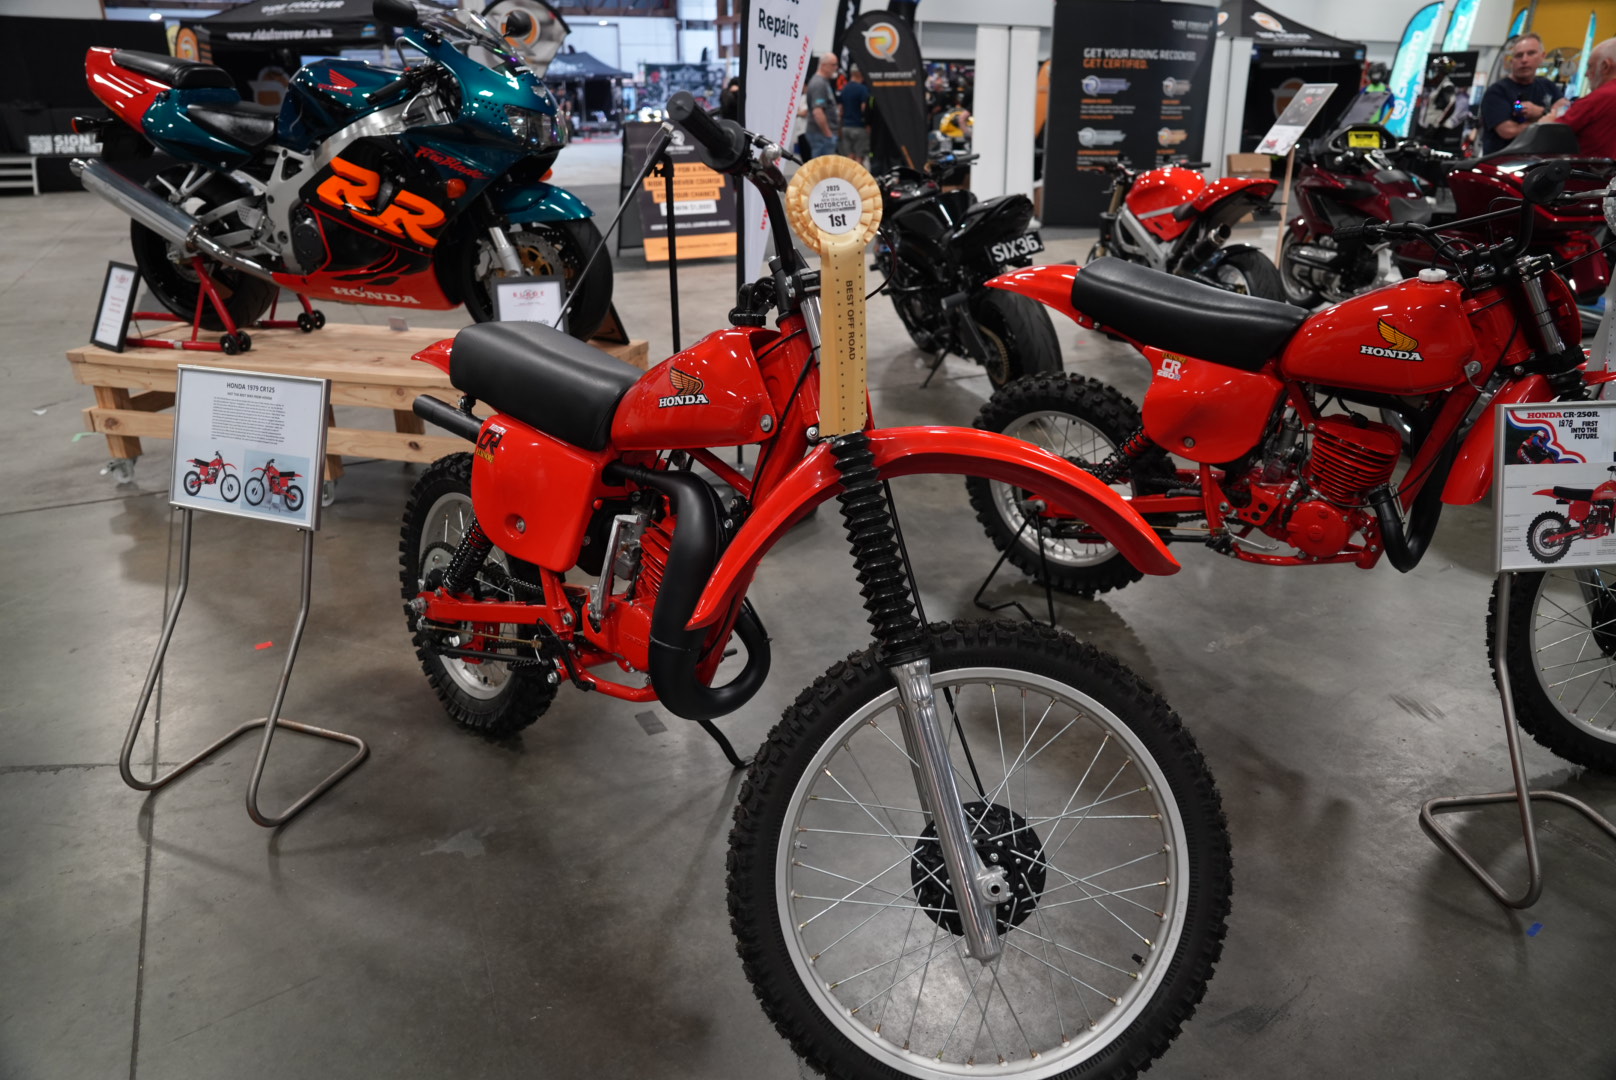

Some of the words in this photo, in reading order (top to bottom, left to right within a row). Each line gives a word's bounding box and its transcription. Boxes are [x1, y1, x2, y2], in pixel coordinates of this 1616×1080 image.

[758, 7, 799, 39] Repairs
[757, 43, 788, 71] Tyres
[1083, 47, 1102, 58] GET
[1103, 47, 1129, 59] YOUR
[1083, 58, 1102, 68] GET
[814, 200, 856, 208] MOTORCYCLE
[828, 213, 847, 227] 1st
[330, 286, 421, 305] HONDA
[845, 280, 854, 306] BEST
[847, 309, 855, 329] OFF
[848, 331, 856, 361] ROAD
[1359, 345, 1423, 361] HONDA
[1161, 358, 1182, 375] CR
[226, 382, 246, 391] HONDA
[247, 384, 259, 392] 1979
[259, 385, 276, 394] CR125
[658, 393, 709, 408] HONDA
[1527, 411, 1563, 419] HONDA
[478, 428, 503, 456] CR
